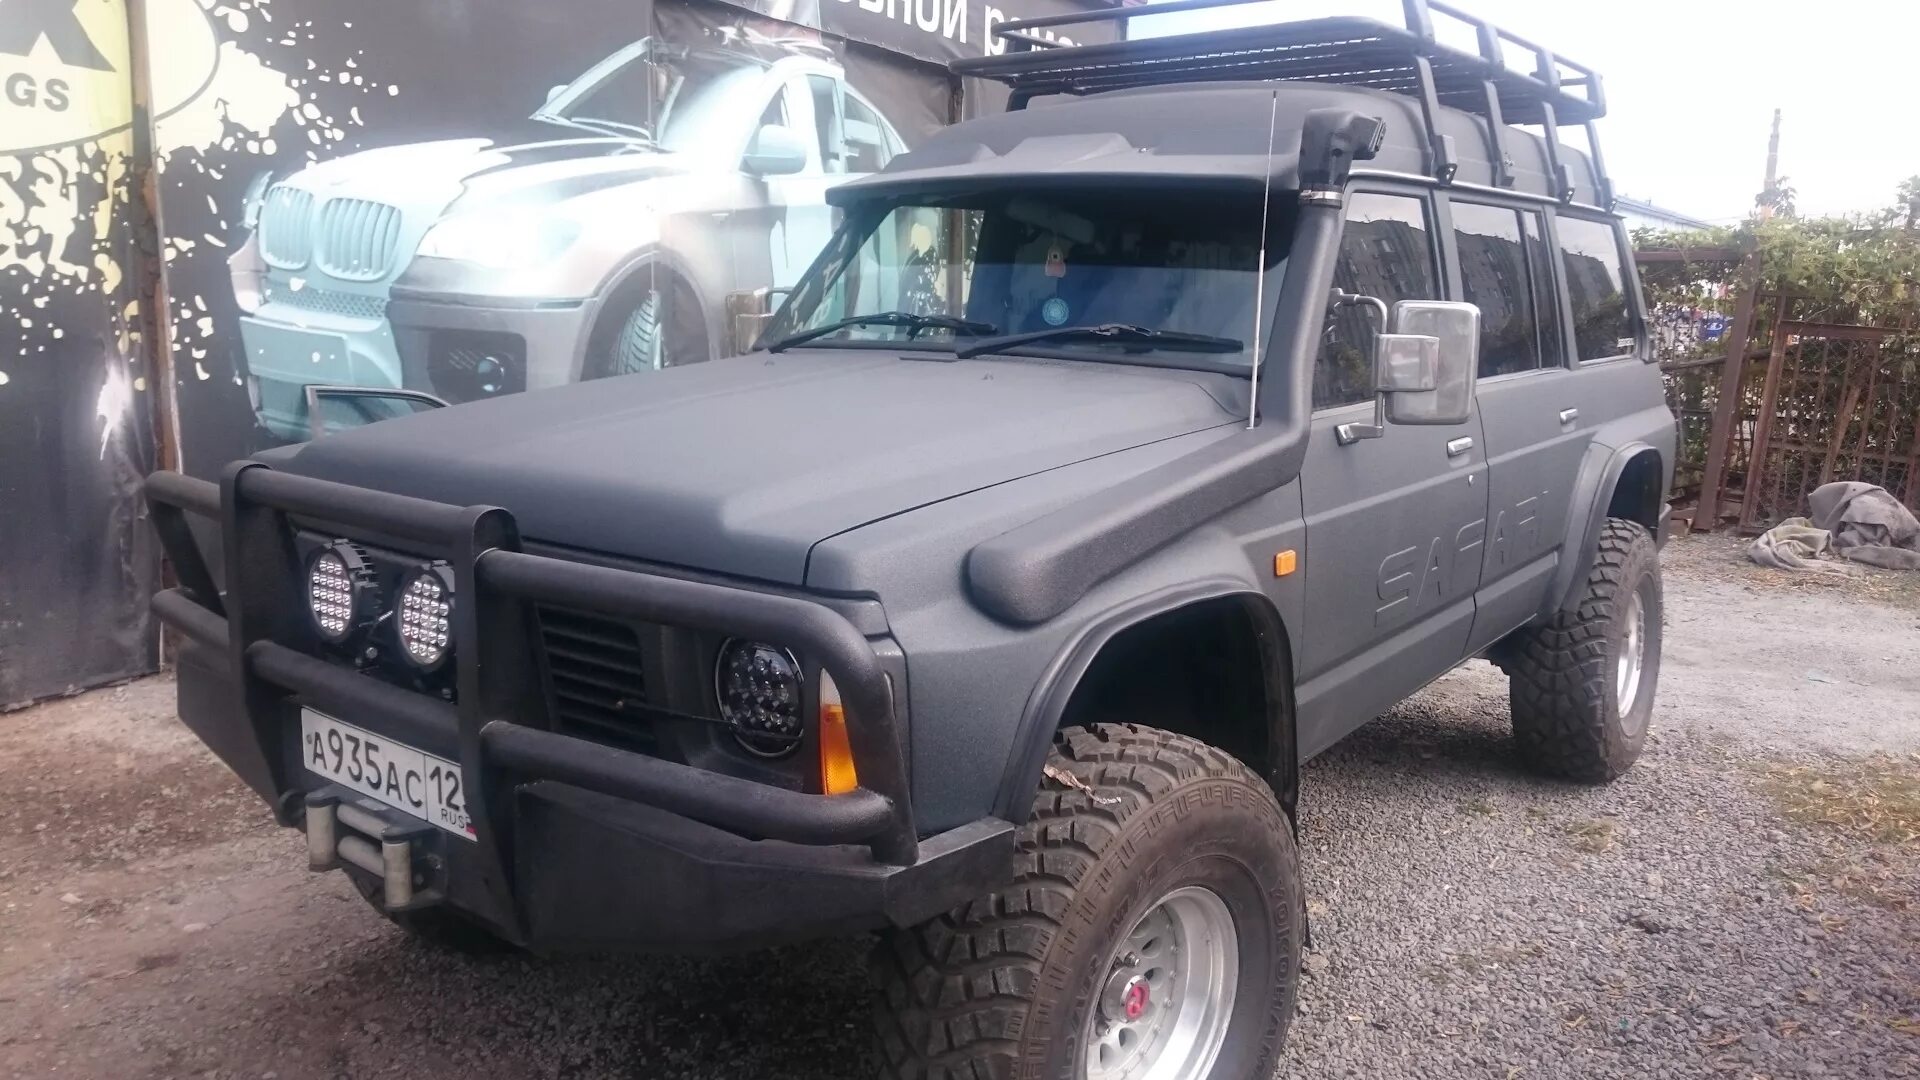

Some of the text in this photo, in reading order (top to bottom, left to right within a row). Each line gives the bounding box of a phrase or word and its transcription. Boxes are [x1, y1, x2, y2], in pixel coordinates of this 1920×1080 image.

[5, 72, 70, 112] GS
[312, 728, 467, 812] A935AC 12
[440, 808, 465, 829] RUS
